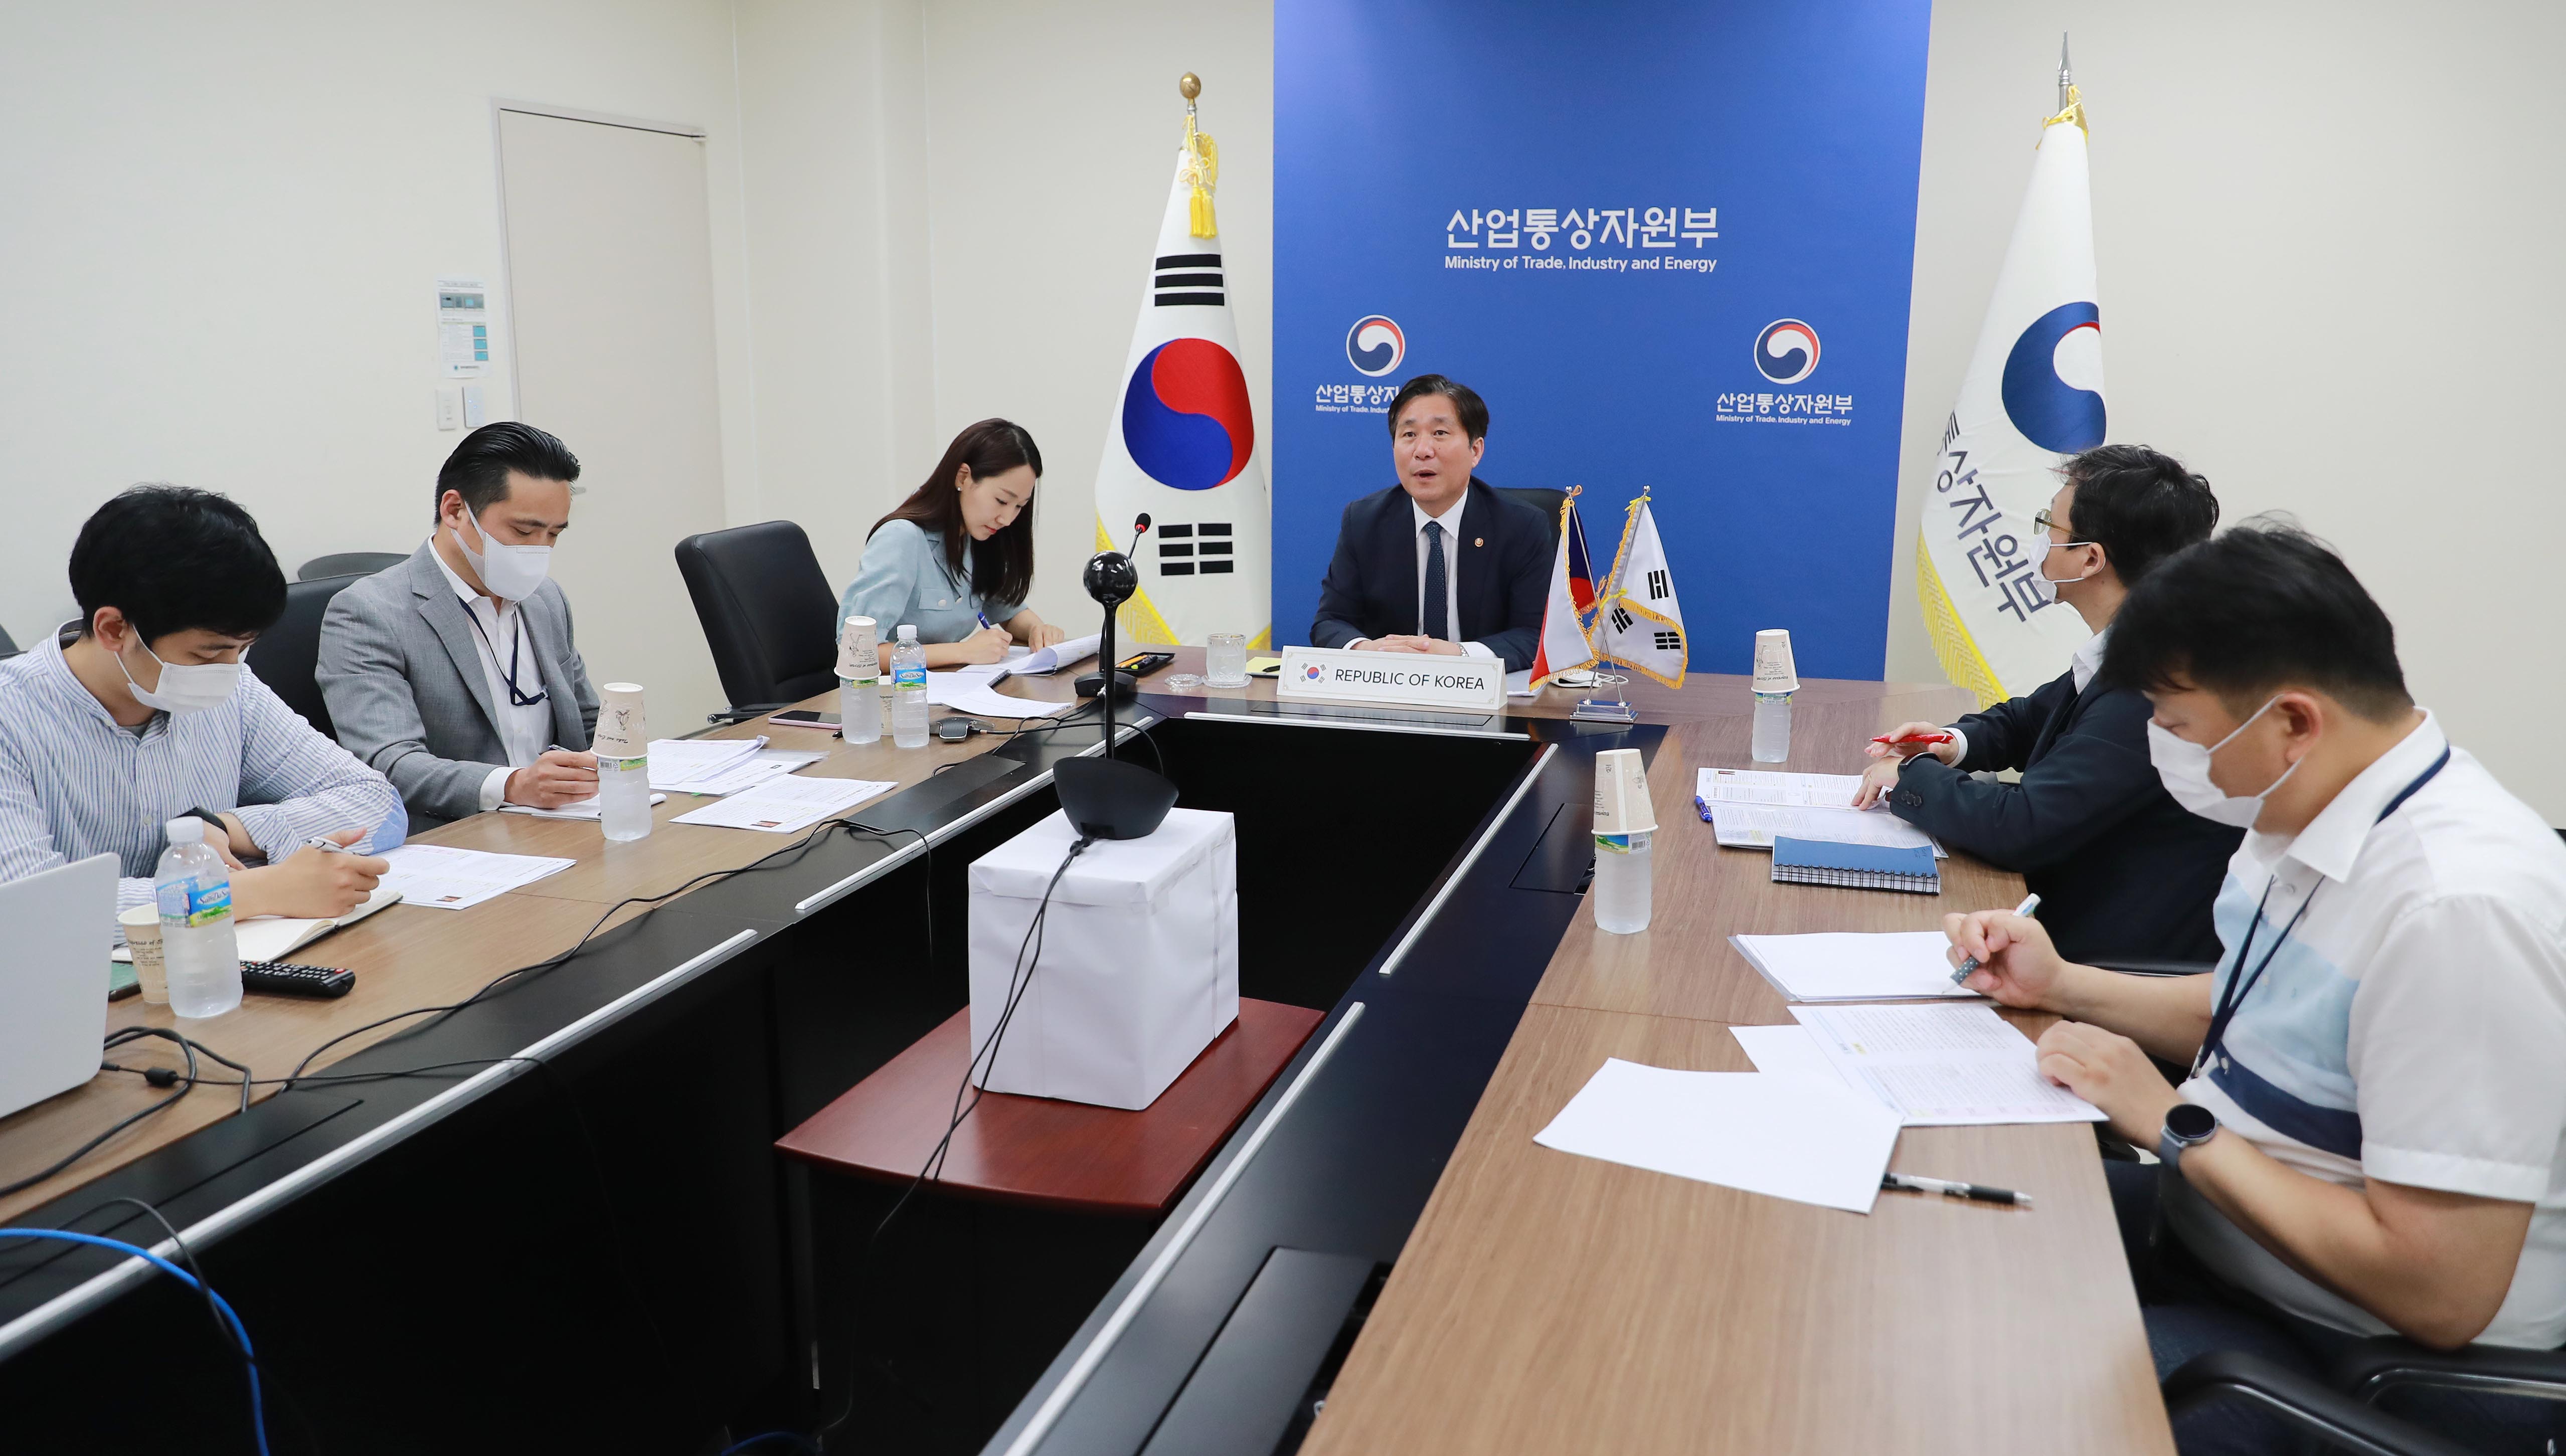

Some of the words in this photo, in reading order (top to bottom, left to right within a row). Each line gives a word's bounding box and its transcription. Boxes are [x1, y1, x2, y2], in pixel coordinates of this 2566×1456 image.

[1446, 206, 1719, 251] 산업통상자원부
[1445, 255, 1500, 272] Ministry
[1503, 255, 1519, 269] of
[1569, 256, 1628, 273] Industry
[1631, 256, 1660, 270] and
[1664, 256, 1718, 273] Energy
[1315, 384, 1400, 405] 산업통상자
[1717, 392, 1853, 415] 산업통상자원부
[1315, 405, 1341, 414] Ministry
[1716, 414, 1745, 424] Ministry
[1778, 416, 1808, 425] Industry
[1825, 417, 1851, 426] Energy
[1335, 669, 1404, 685] REPUBLIC
[1409, 673, 1430, 686] OF
[1434, 675, 1485, 690] KOREA
